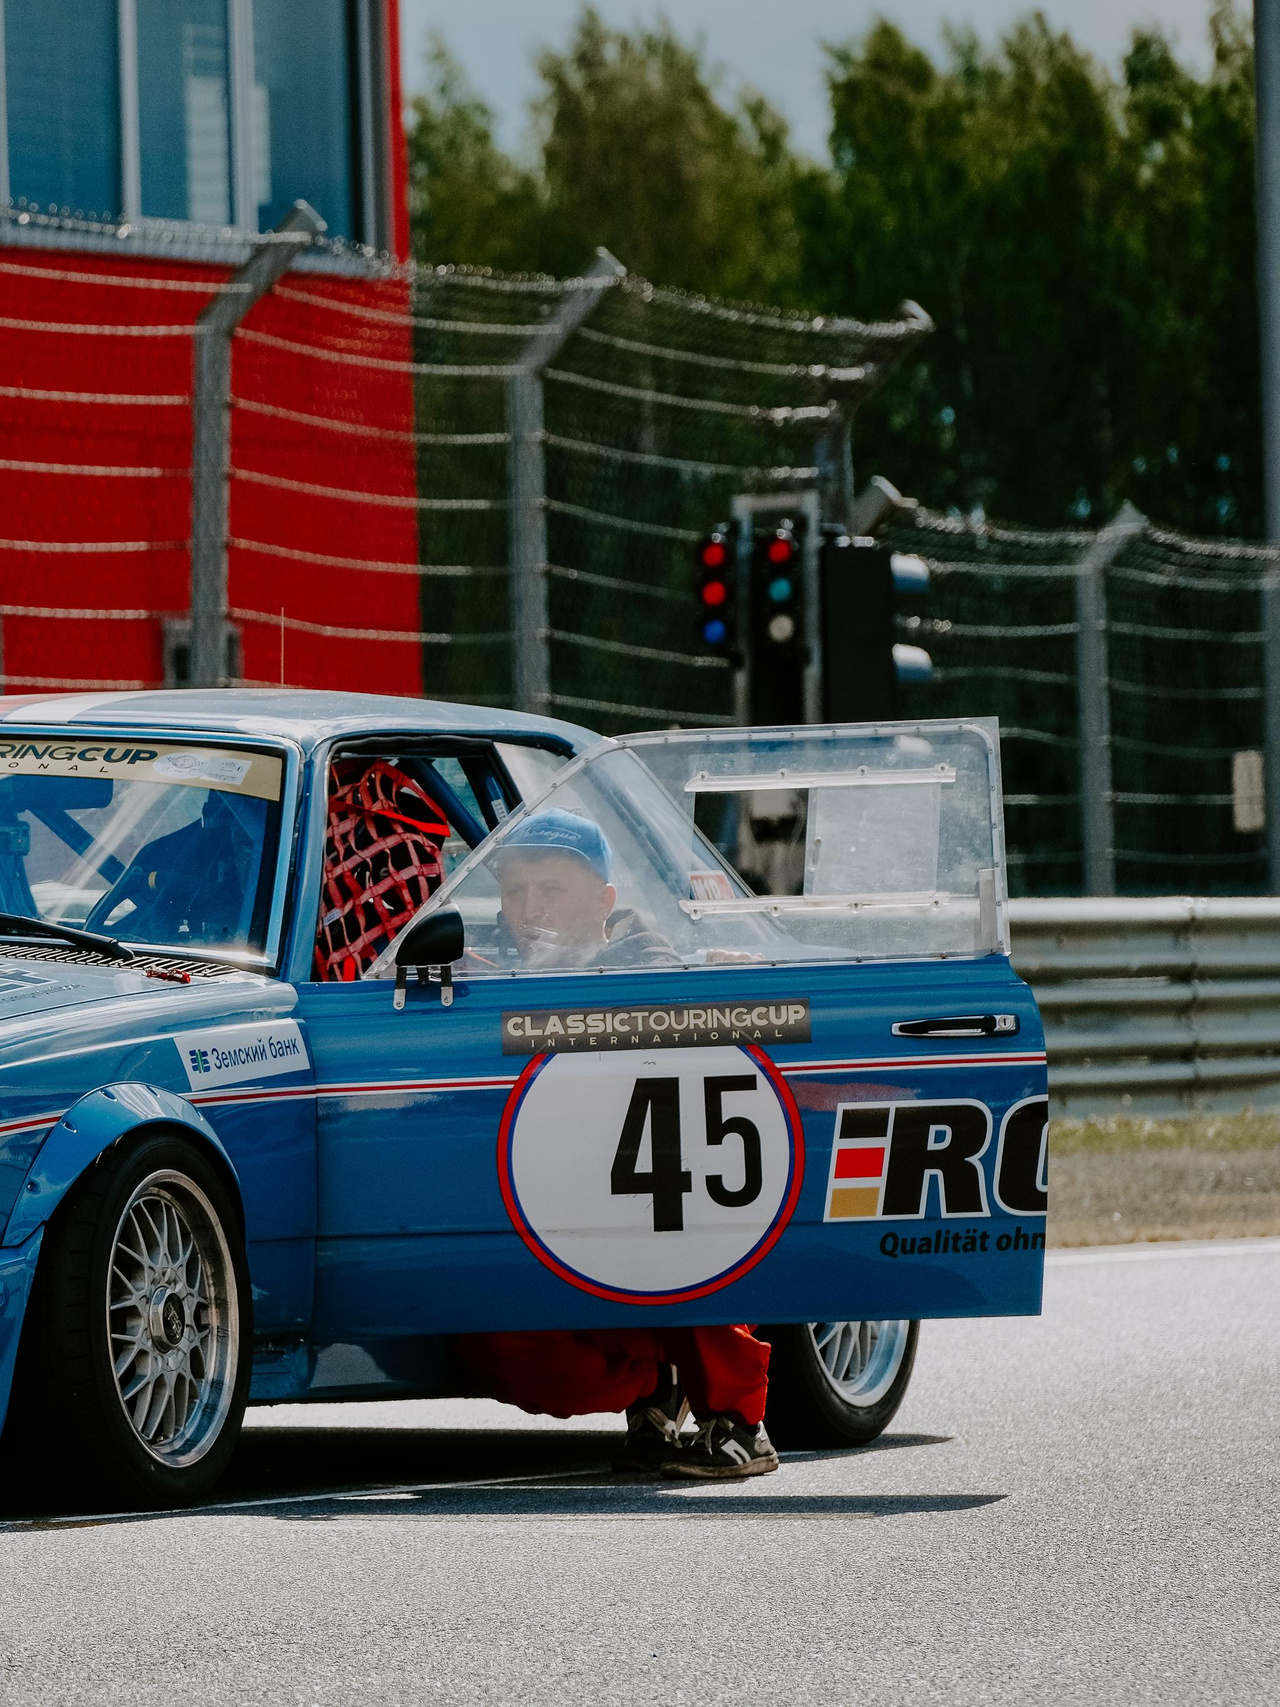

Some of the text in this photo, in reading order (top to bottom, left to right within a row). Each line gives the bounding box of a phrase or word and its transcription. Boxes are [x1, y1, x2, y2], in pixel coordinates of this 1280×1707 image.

[506, 1004, 806, 1037] CLASSICTOURINGCUP
[211, 1036, 300, 1070] Земский банк
[531, 1028, 783, 1047] INTERNATIONAL
[610, 1074, 763, 1232] 45
[879, 1228, 990, 1259] Qualität
